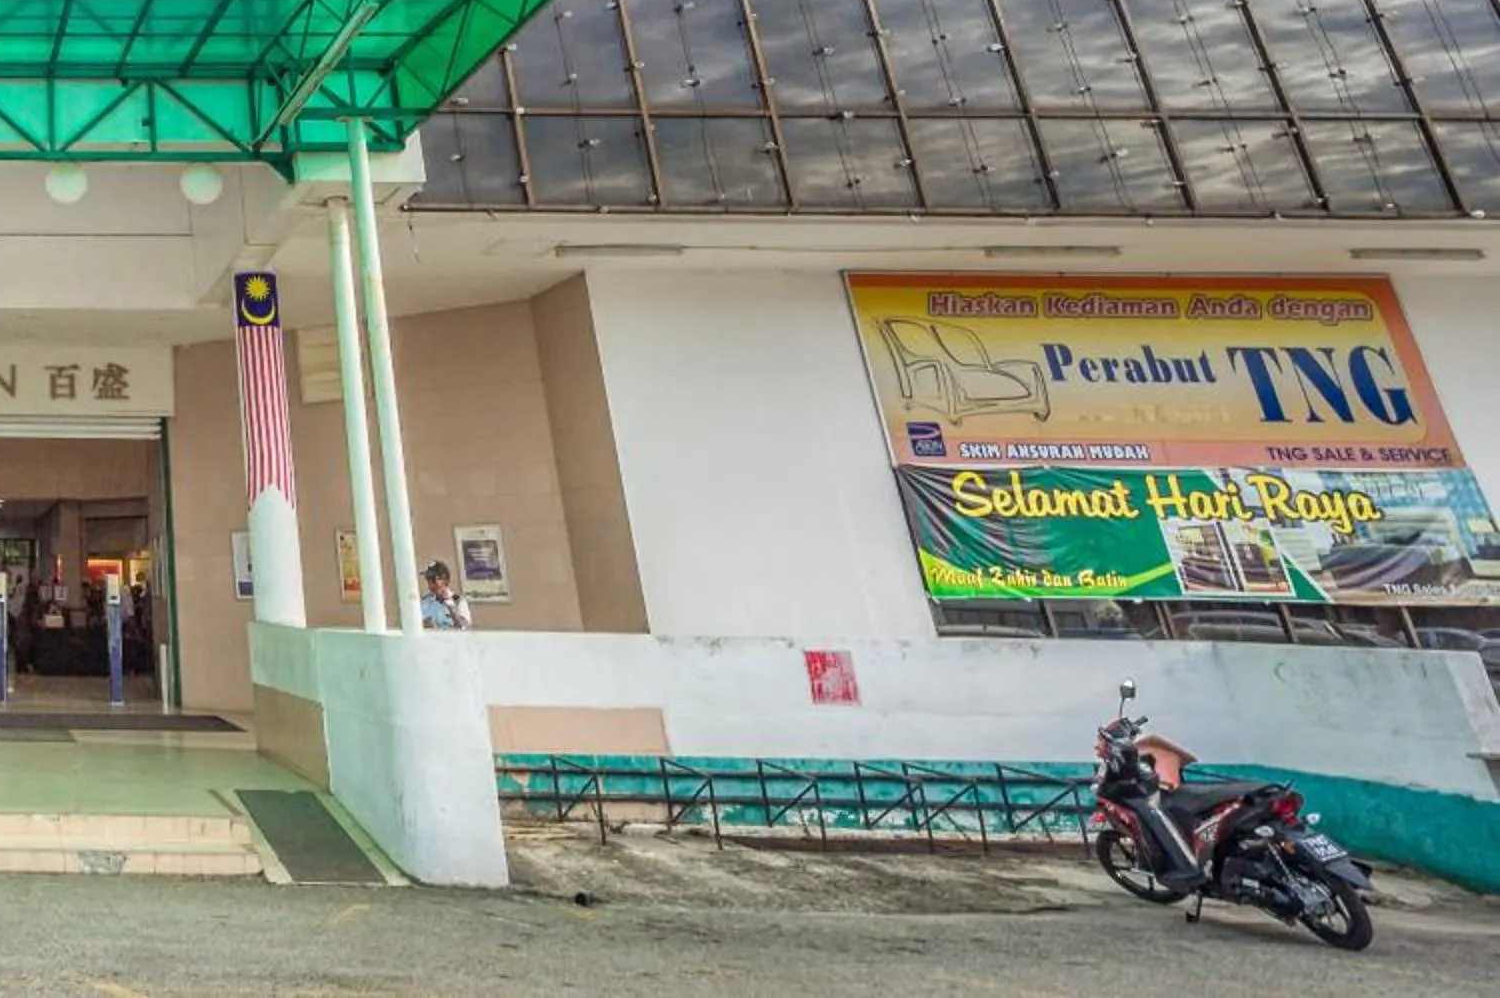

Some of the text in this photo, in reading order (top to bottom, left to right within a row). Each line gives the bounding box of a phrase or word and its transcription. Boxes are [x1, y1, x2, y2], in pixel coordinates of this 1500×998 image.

[929, 292, 1371, 325] Hiaskan Kediaman Anda dengan
[45, 363, 131, 401] 百盛
[1040, 343, 1418, 425] Perabut TNG
[959, 443, 1001, 459] SKIM
[1006, 444, 1085, 459] ANSURAN
[1088, 445, 1149, 459] MUDAH
[1266, 446, 1452, 462] TNG SALE & SERVICE
[950, 471, 1384, 535] Selamat Hari Raya
[1041, 568, 1073, 587] dan
